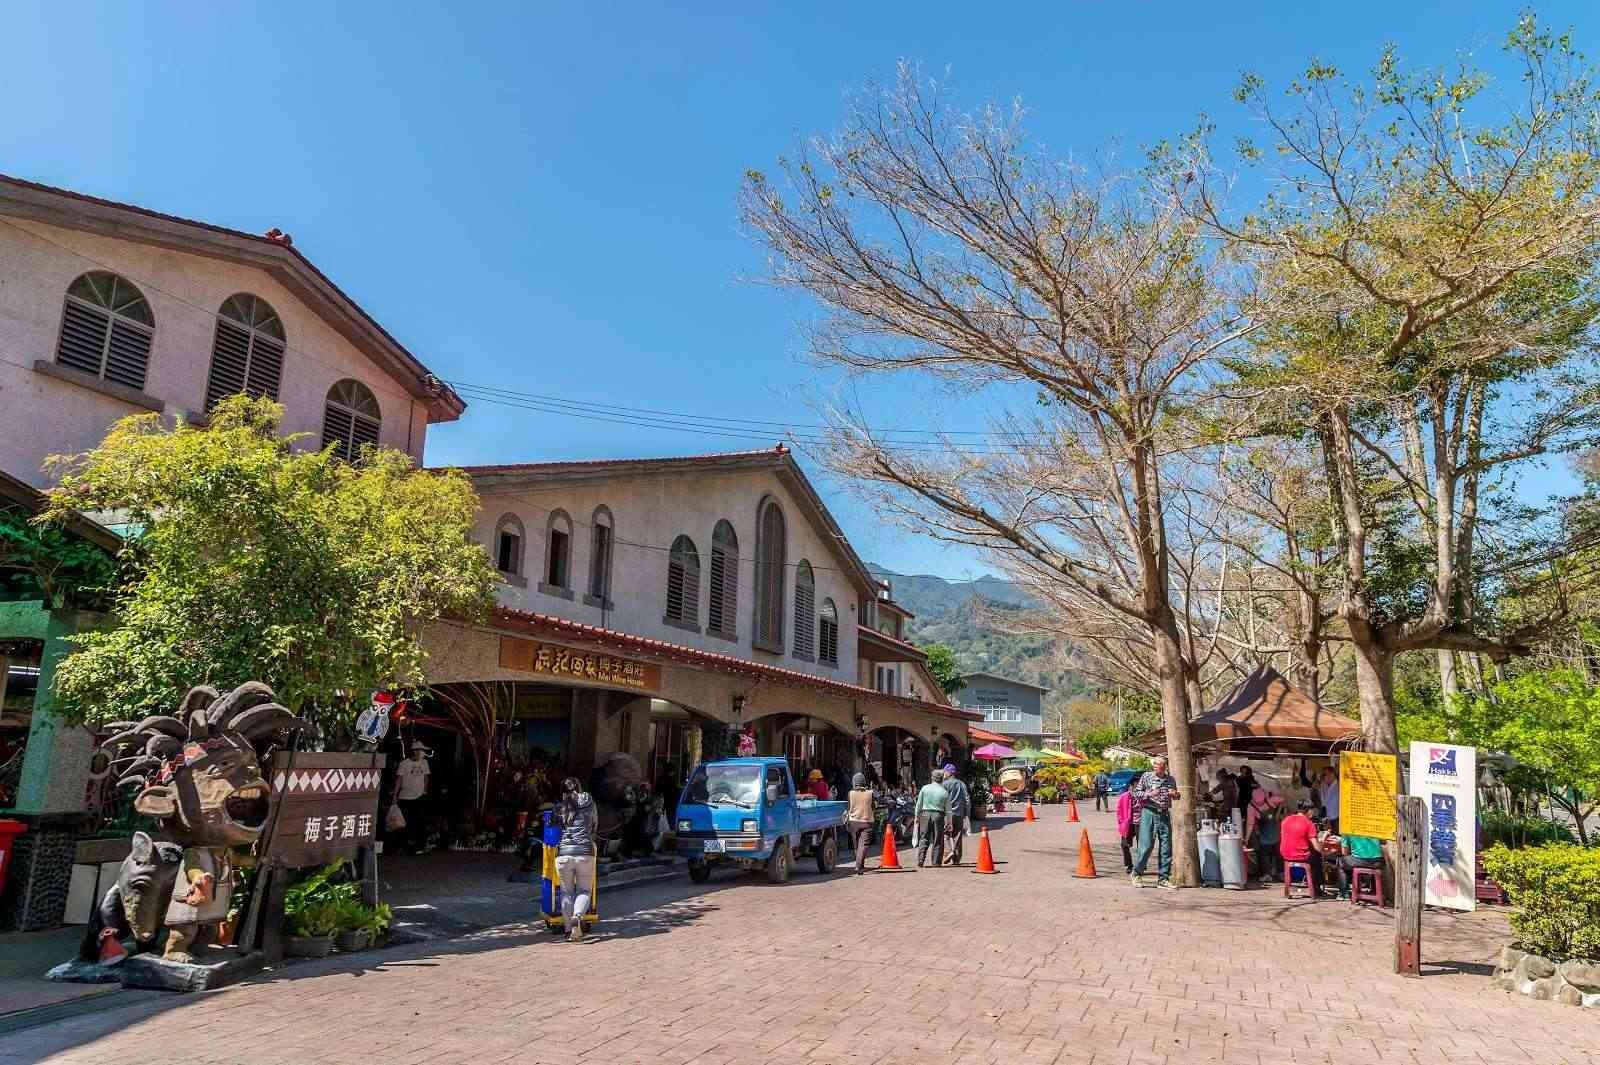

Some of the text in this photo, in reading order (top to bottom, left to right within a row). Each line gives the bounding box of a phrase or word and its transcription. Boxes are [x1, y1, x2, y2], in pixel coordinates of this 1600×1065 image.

[1431, 767, 1457, 777] Hakka
[304, 814, 372, 843] 梅子酒莊
